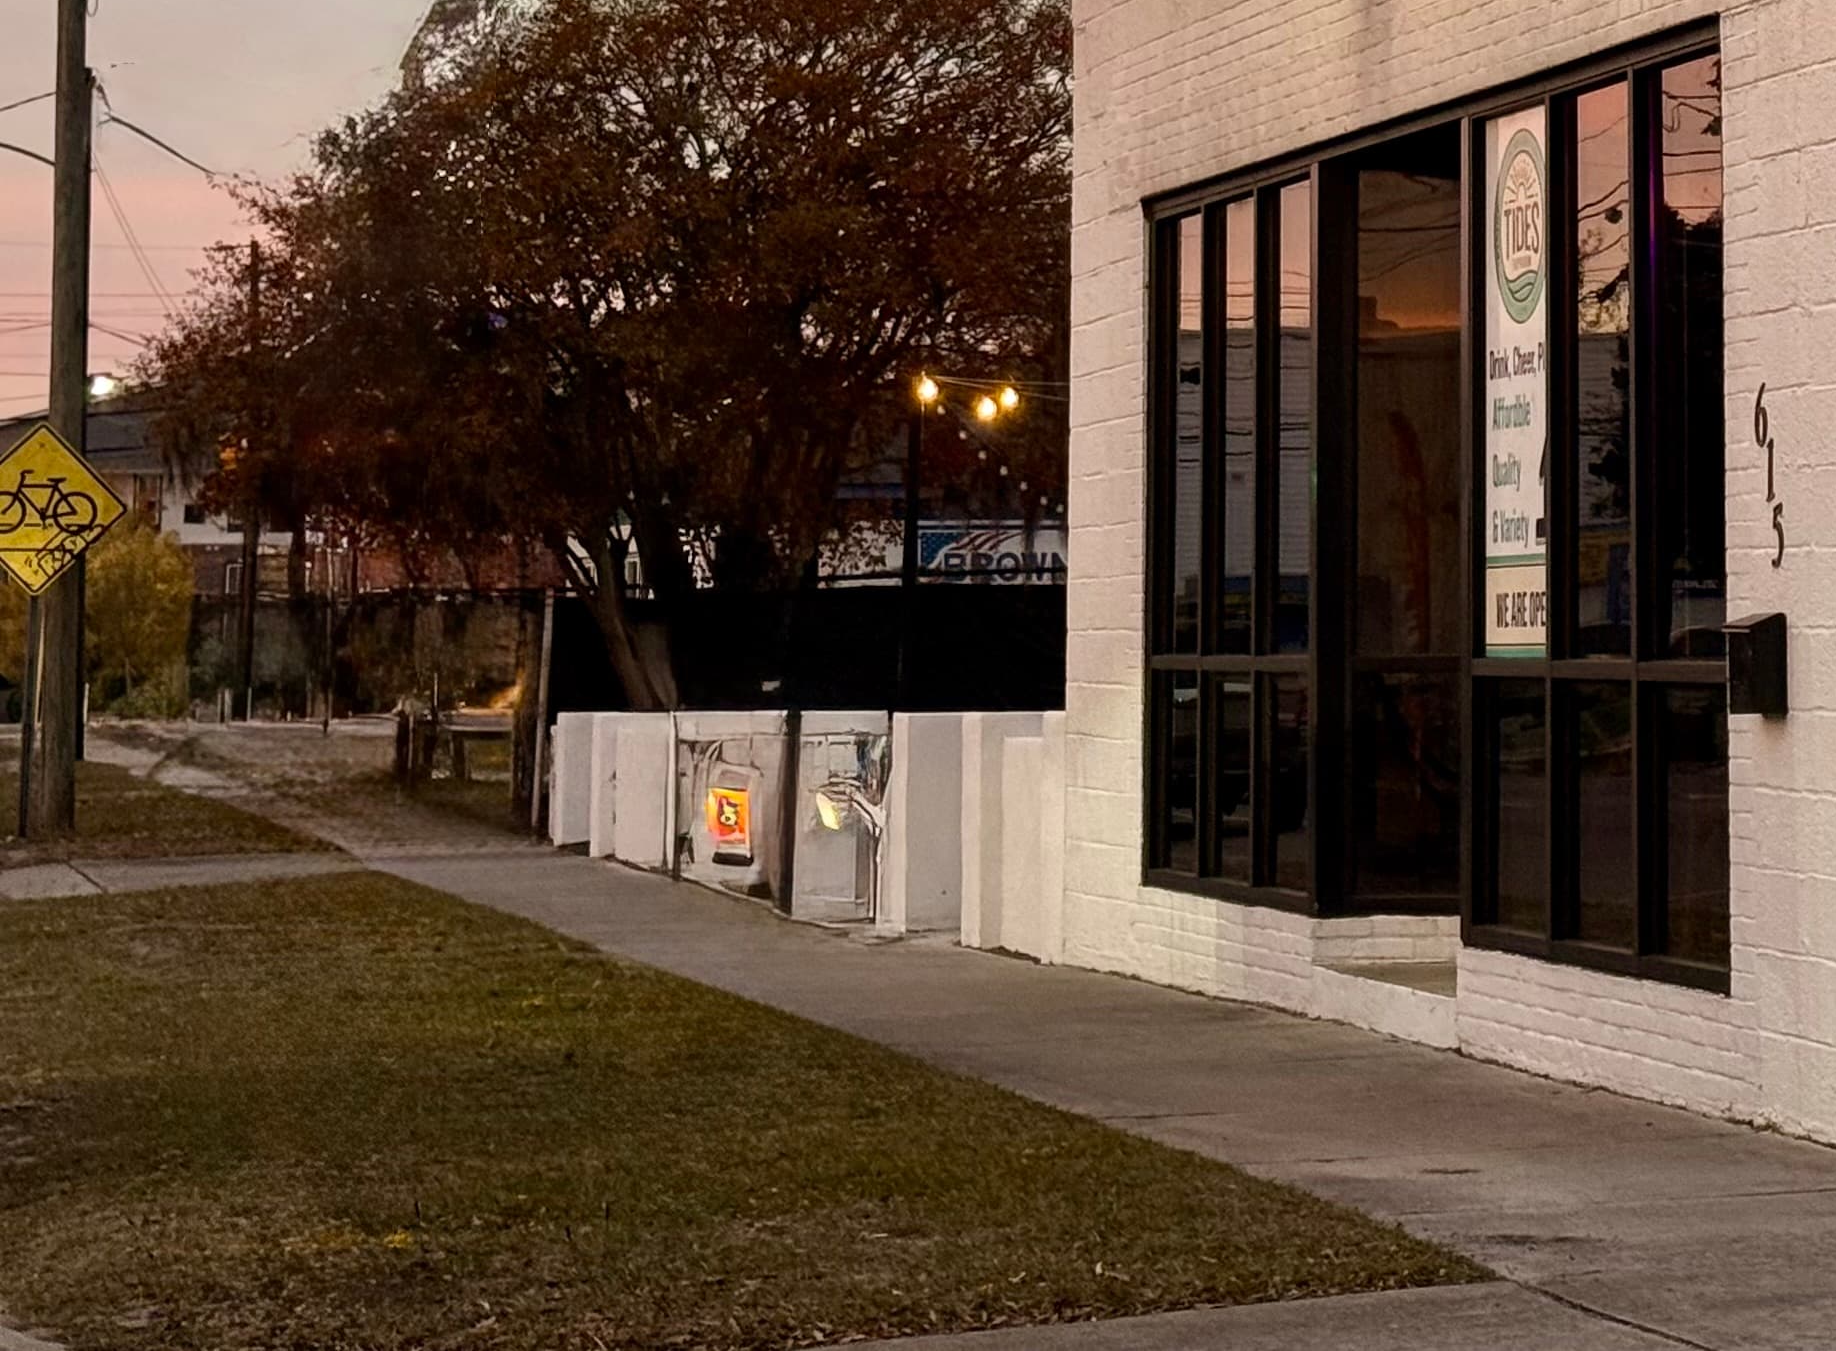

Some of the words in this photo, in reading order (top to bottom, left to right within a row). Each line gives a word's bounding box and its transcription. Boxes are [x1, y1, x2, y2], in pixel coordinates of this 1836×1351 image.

[1504, 200, 1540, 260] TIDES
[1493, 452, 1521, 492] Quality
[1500, 508, 1529, 548] Variety
[1496, 592, 1509, 628] WE
[1511, 591, 1527, 628] ARE
